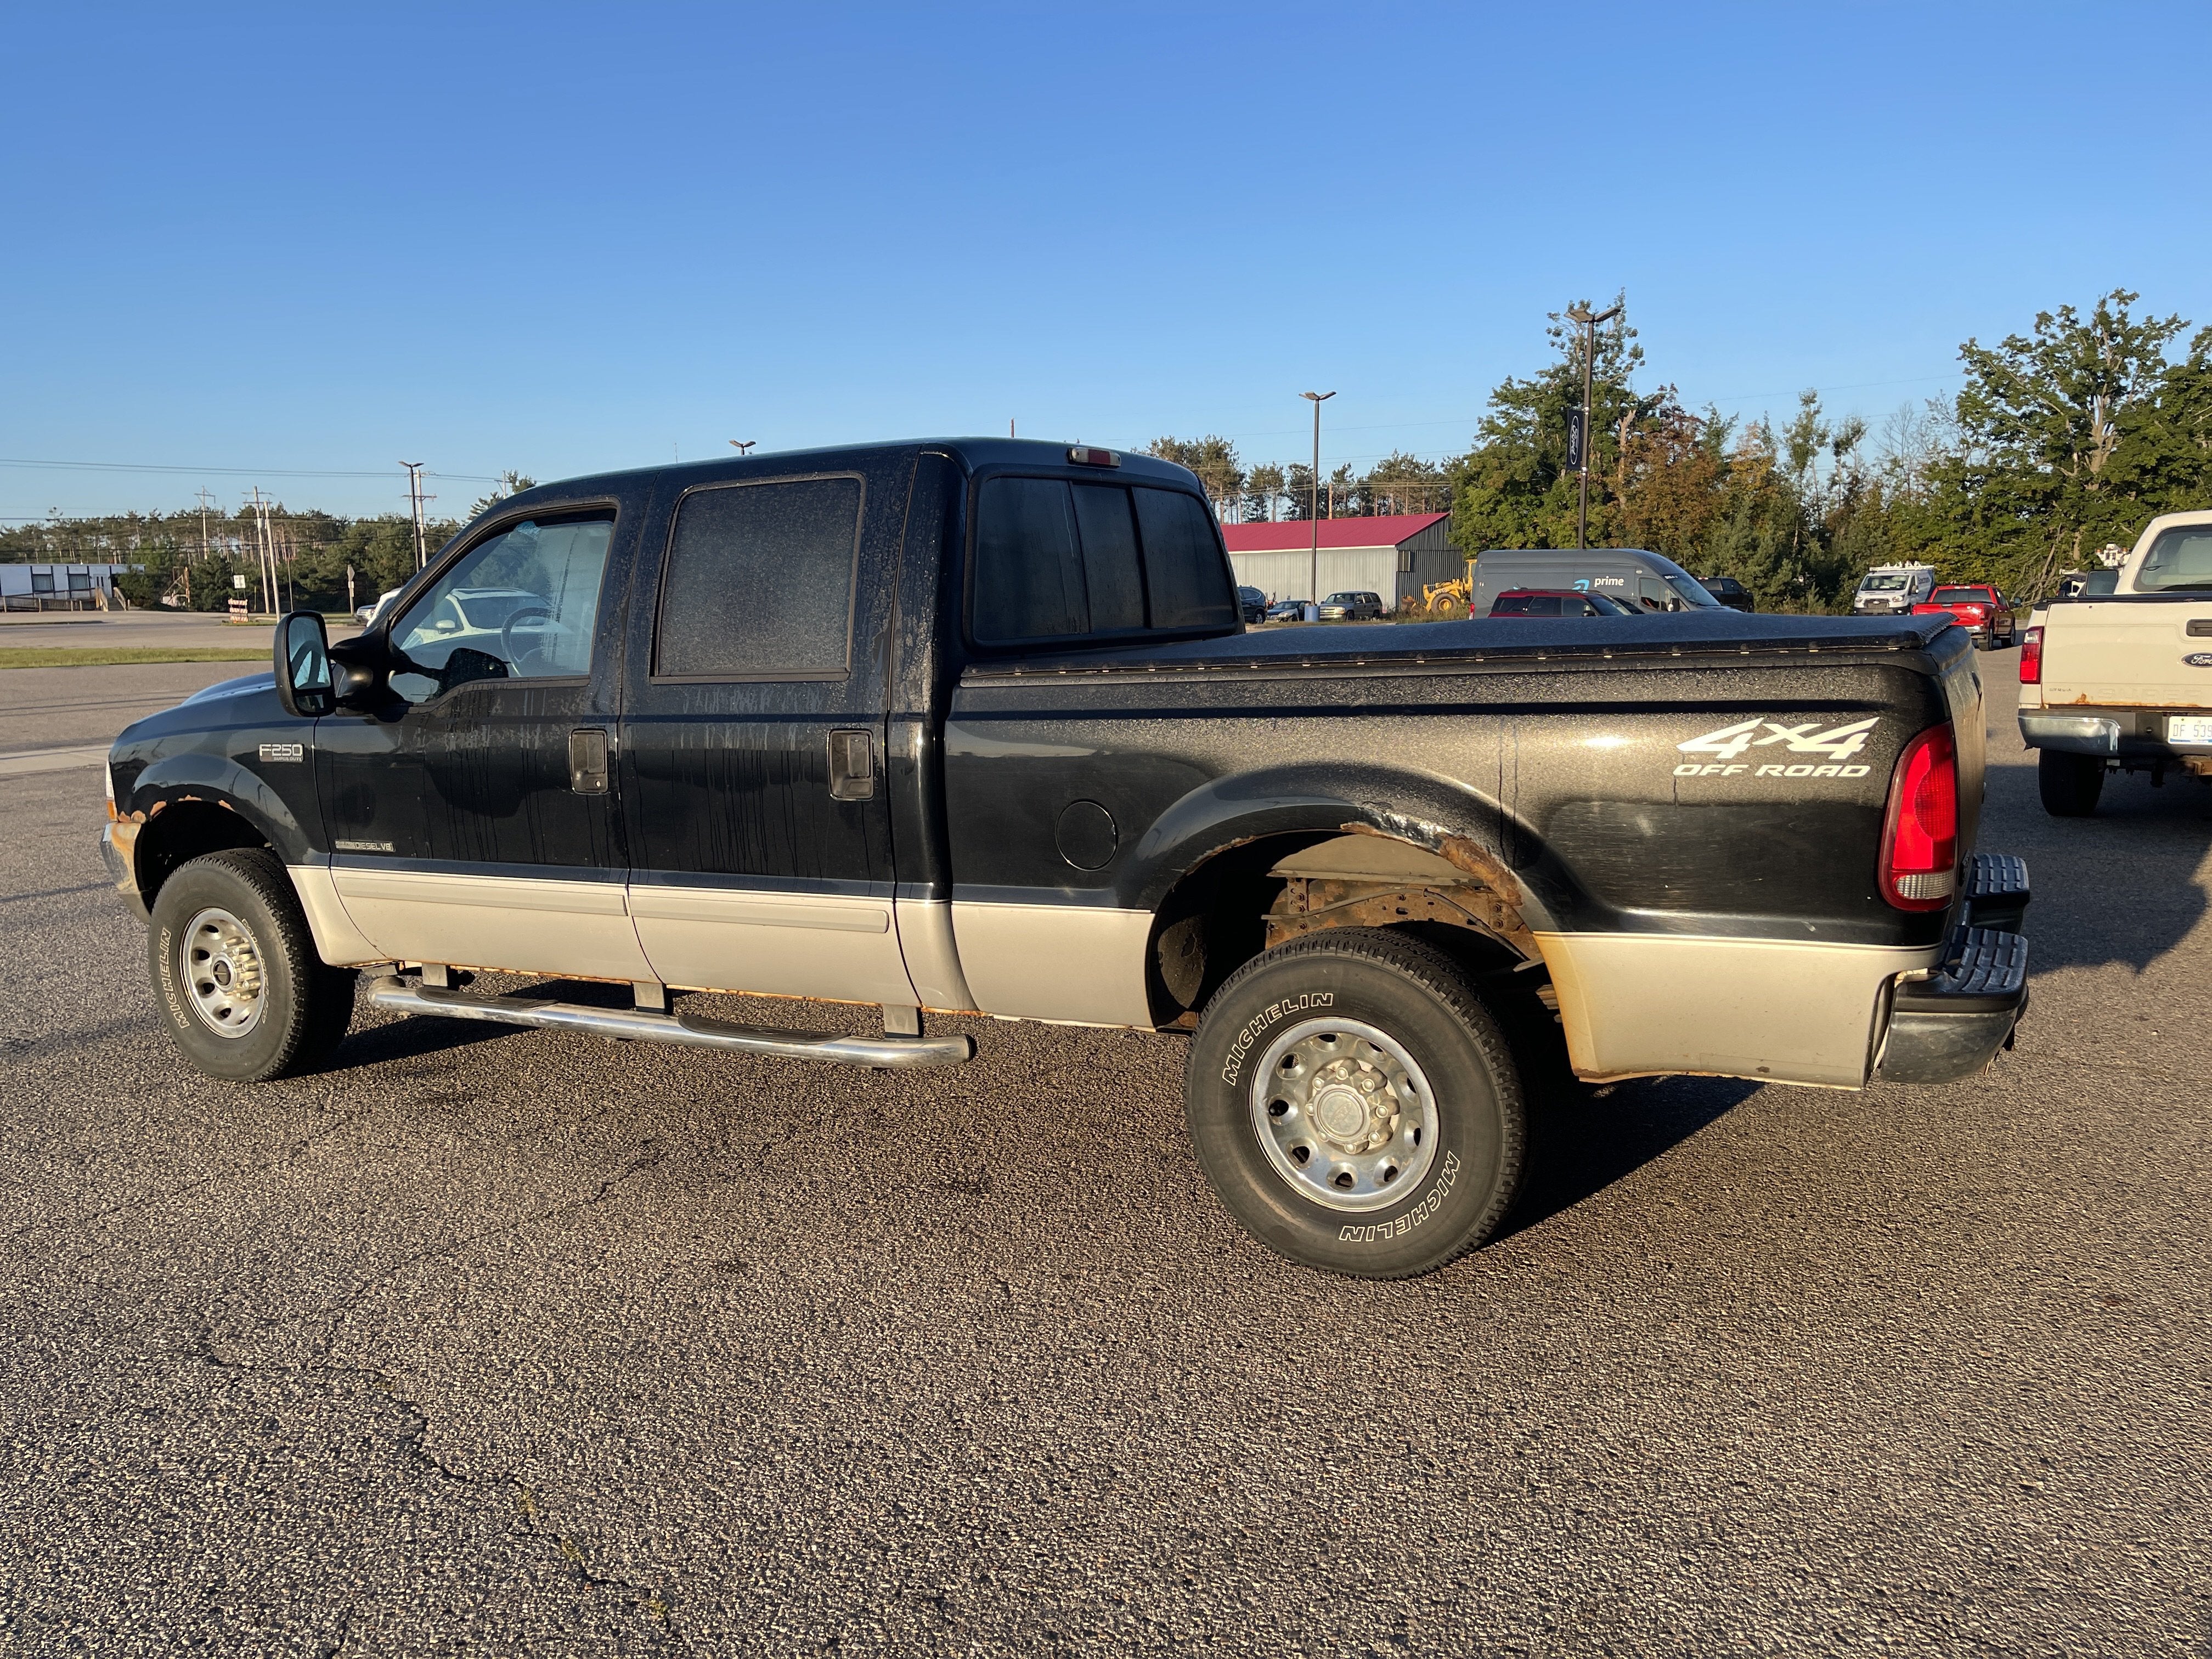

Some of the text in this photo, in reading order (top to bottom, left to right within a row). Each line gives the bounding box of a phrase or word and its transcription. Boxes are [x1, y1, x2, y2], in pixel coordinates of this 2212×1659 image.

[1594, 575, 1624, 588] prime
[259, 744, 303, 757] F250
[1673, 764, 1871, 777] OFF ROAD
[160, 927, 190, 1029] MICHELIN
[1222, 993, 1333, 1086] MICHELIN
[1339, 1150, 1460, 1242] MICHELIN
